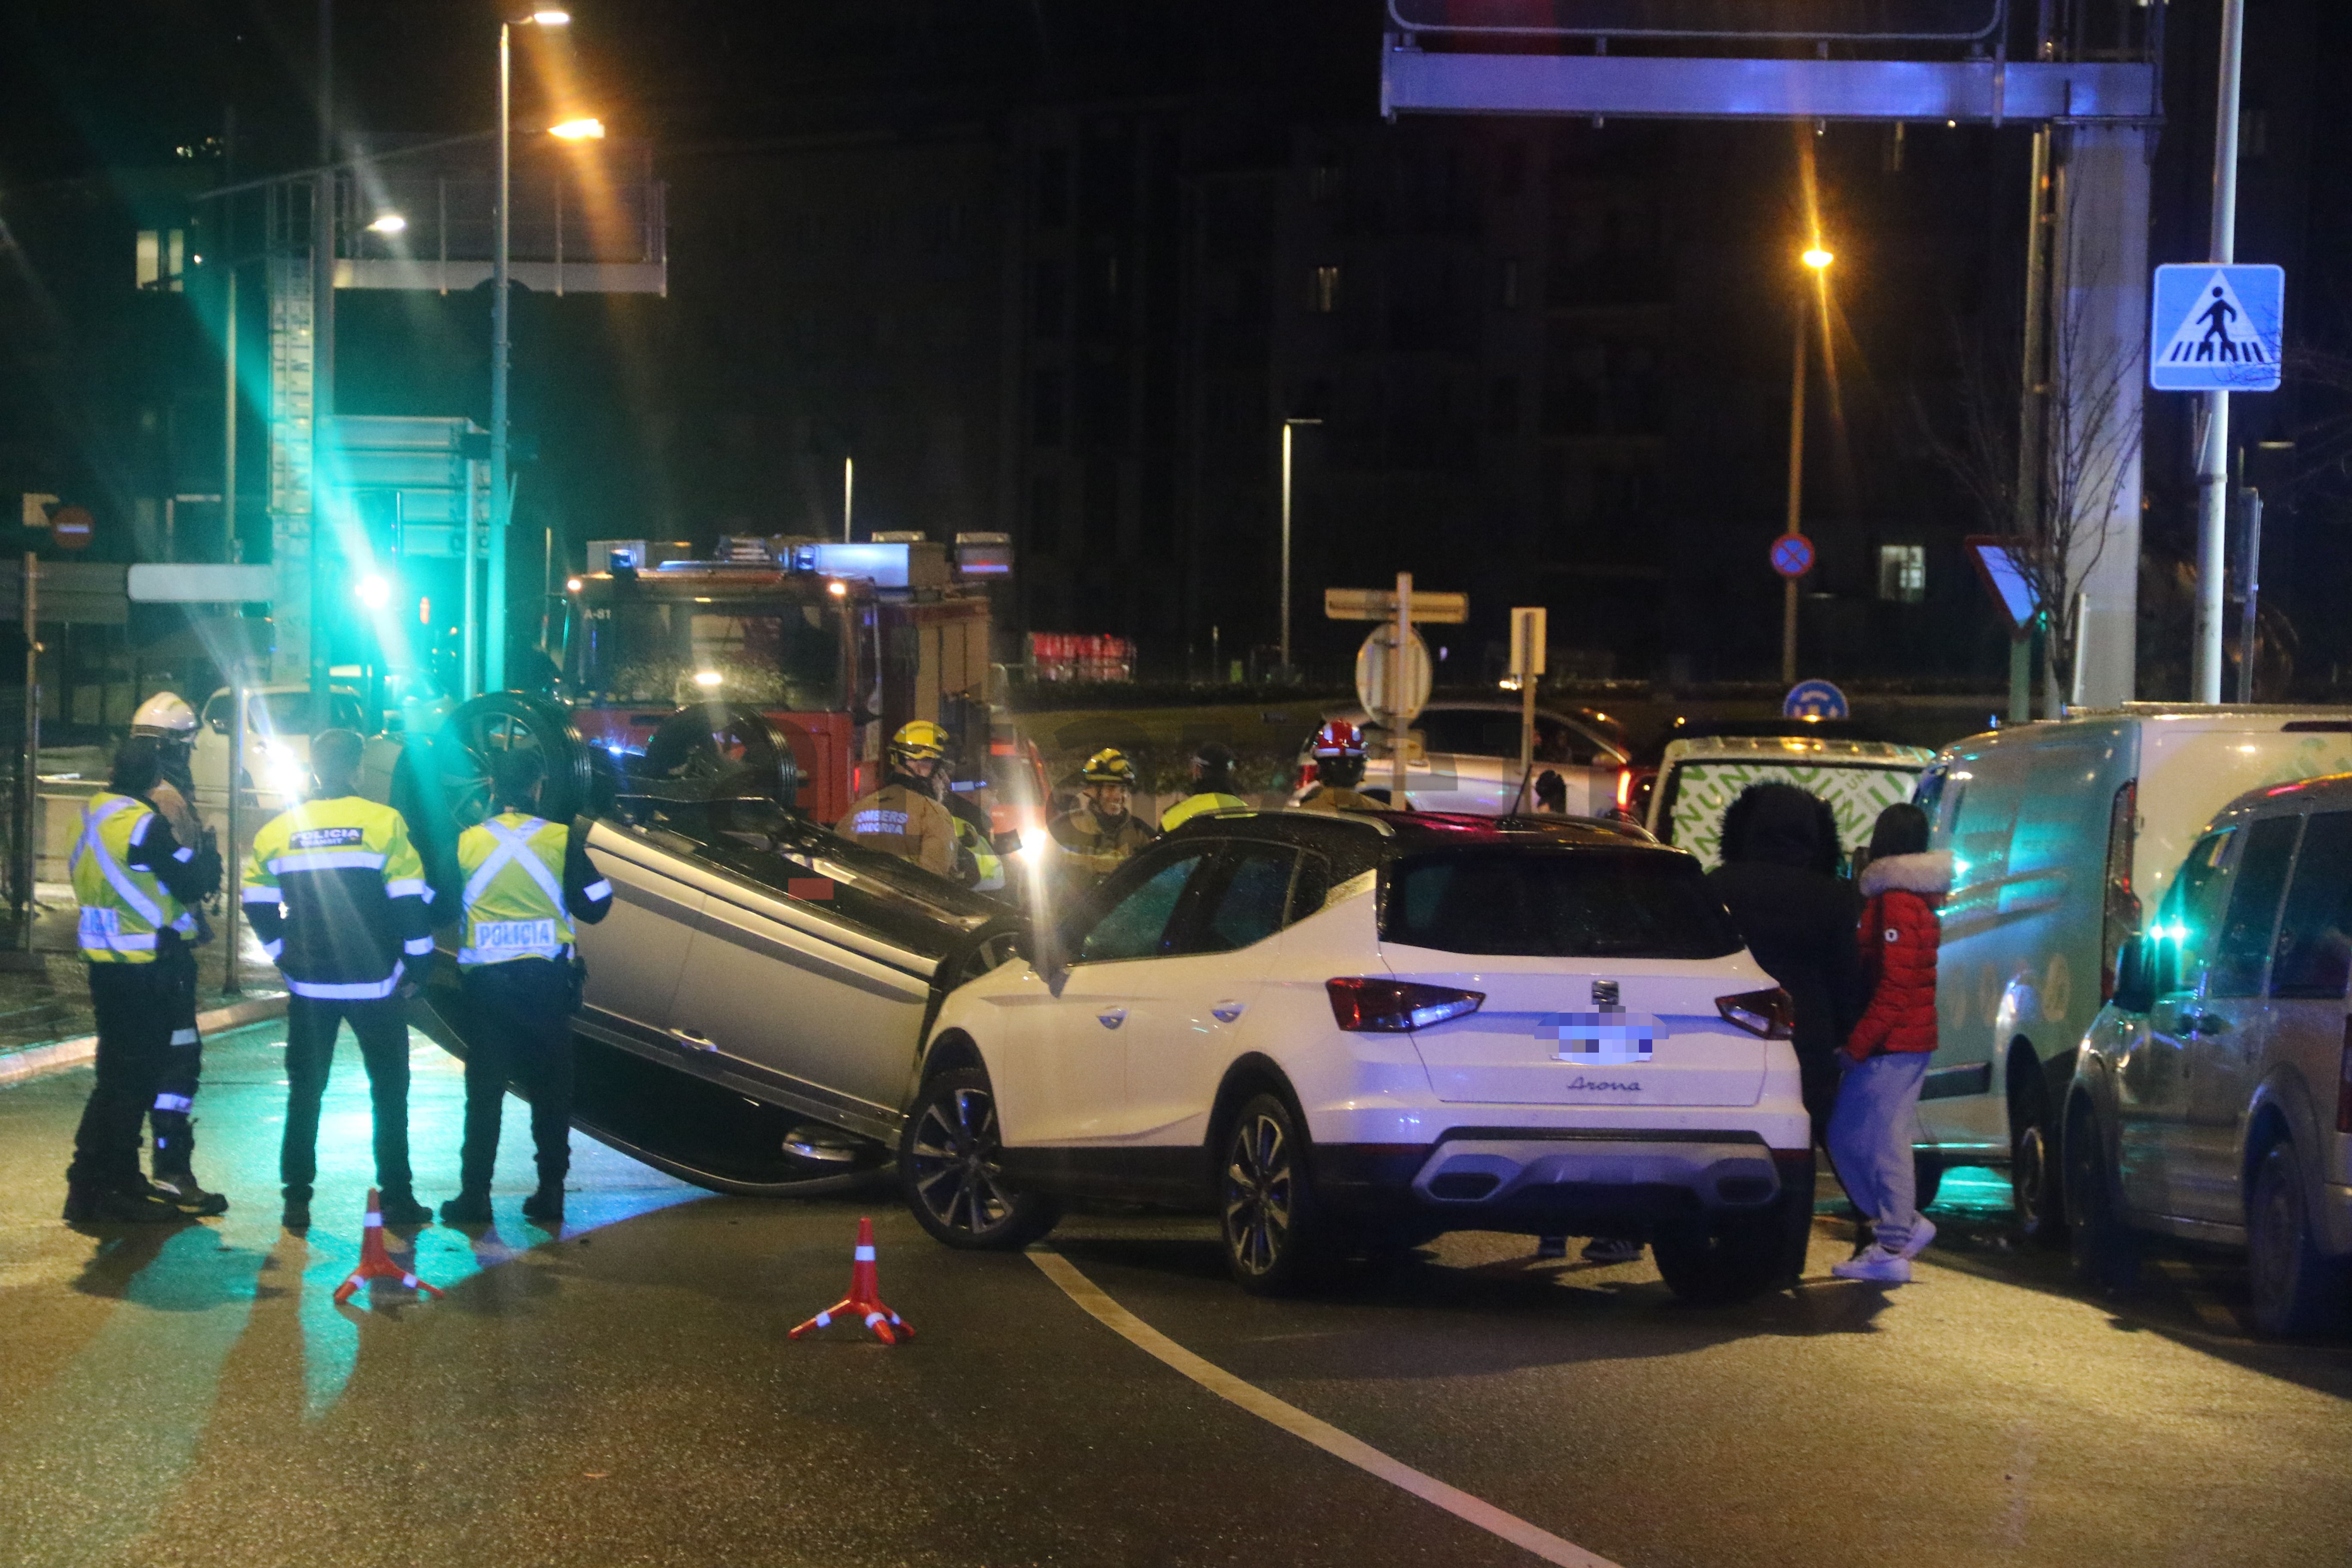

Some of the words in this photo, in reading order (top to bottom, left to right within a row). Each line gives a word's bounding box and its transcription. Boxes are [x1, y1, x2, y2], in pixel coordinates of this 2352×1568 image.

[291, 829, 360, 841] POLICIA
[480, 923, 550, 946] POLICIA
[1568, 1076, 1643, 1091] Arona
